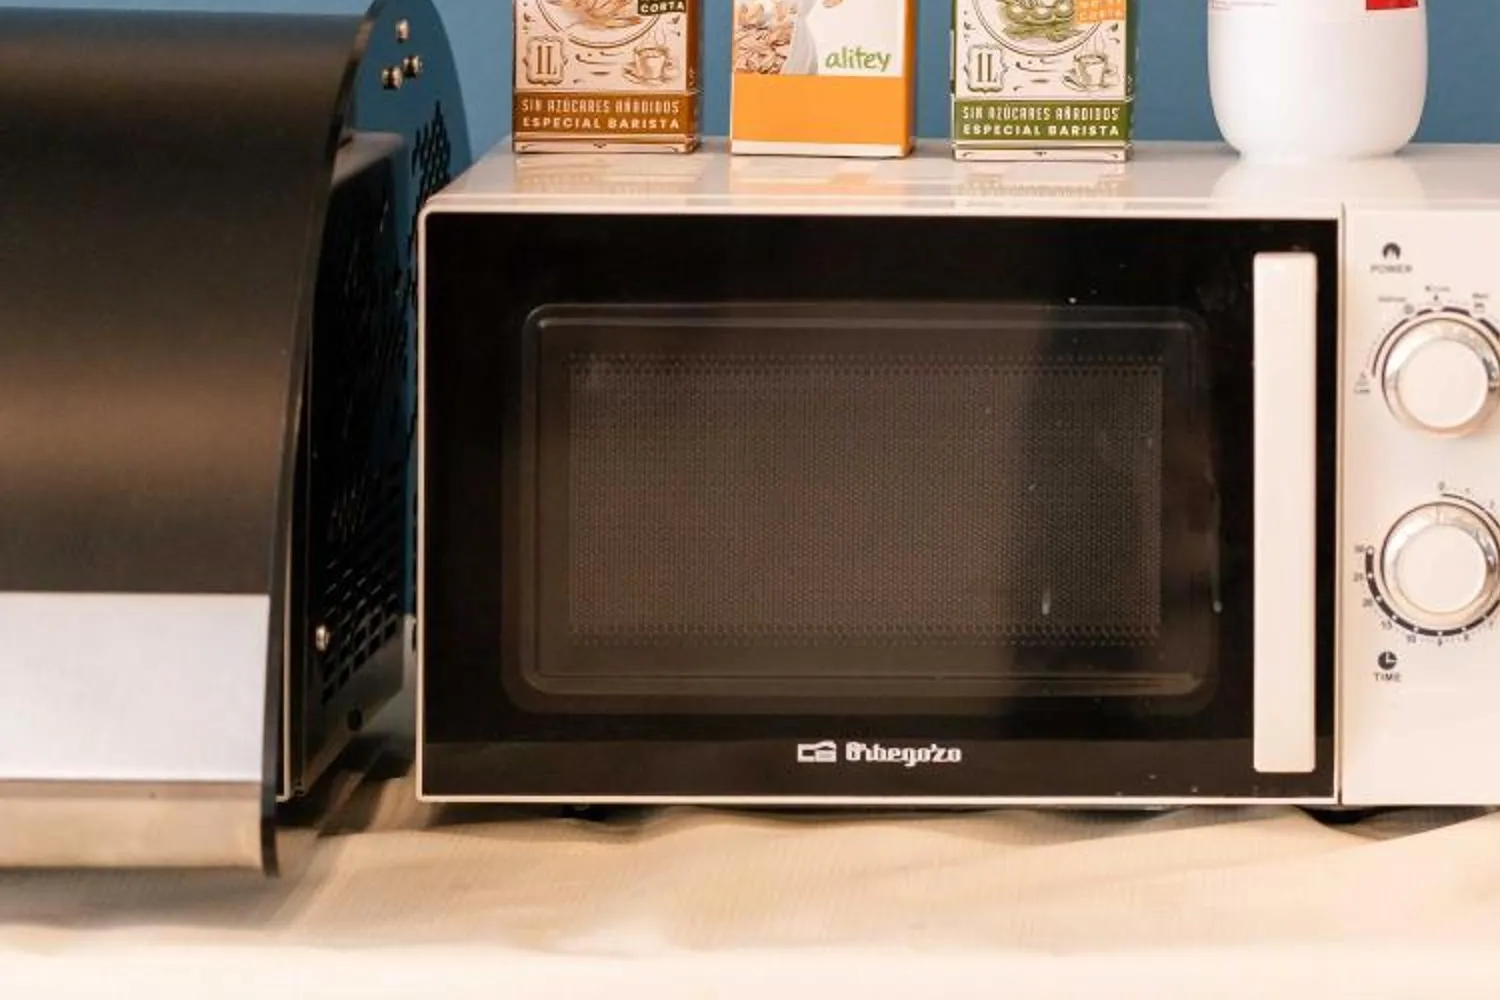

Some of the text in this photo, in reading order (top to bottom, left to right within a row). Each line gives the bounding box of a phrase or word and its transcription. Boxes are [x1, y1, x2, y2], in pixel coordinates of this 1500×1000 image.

[641, 1, 685, 13] CORTA
[521, 99, 542, 113] SIN
[962, 106, 984, 120] SIN
[987, 104, 1051, 121] AZÚCARES
[522, 117, 680, 129] ESPECIAL BARISTA
[962, 123, 1120, 137] ESPECIAL BARISTA
[1374, 672, 1401, 682] TIME
